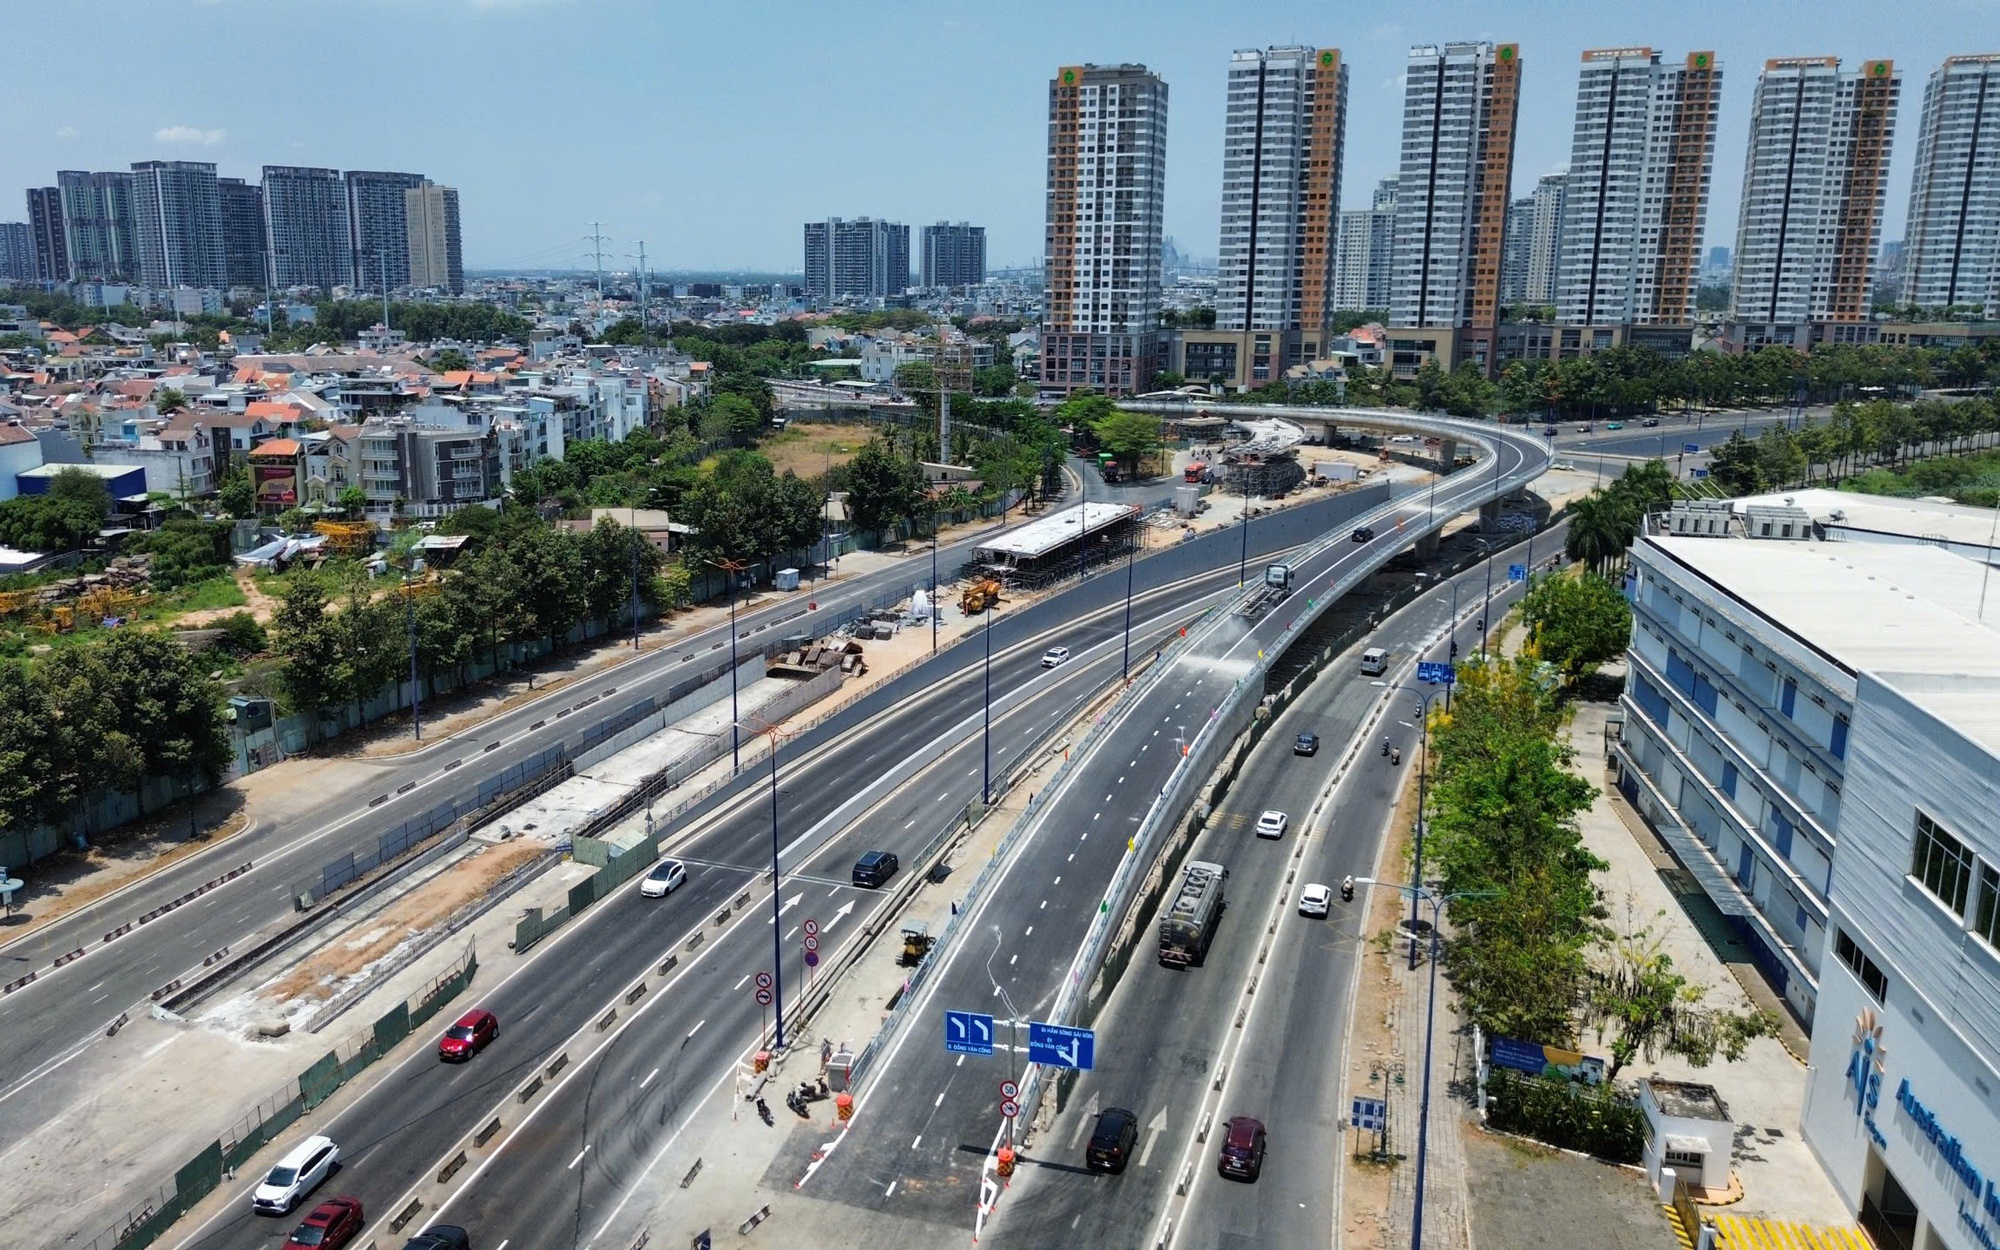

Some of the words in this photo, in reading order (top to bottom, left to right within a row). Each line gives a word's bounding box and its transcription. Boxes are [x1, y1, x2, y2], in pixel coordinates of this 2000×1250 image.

[808, 939, 815, 947] 50
[1005, 1086, 1014, 1095] 50
[1896, 1078, 1982, 1198] Australian
